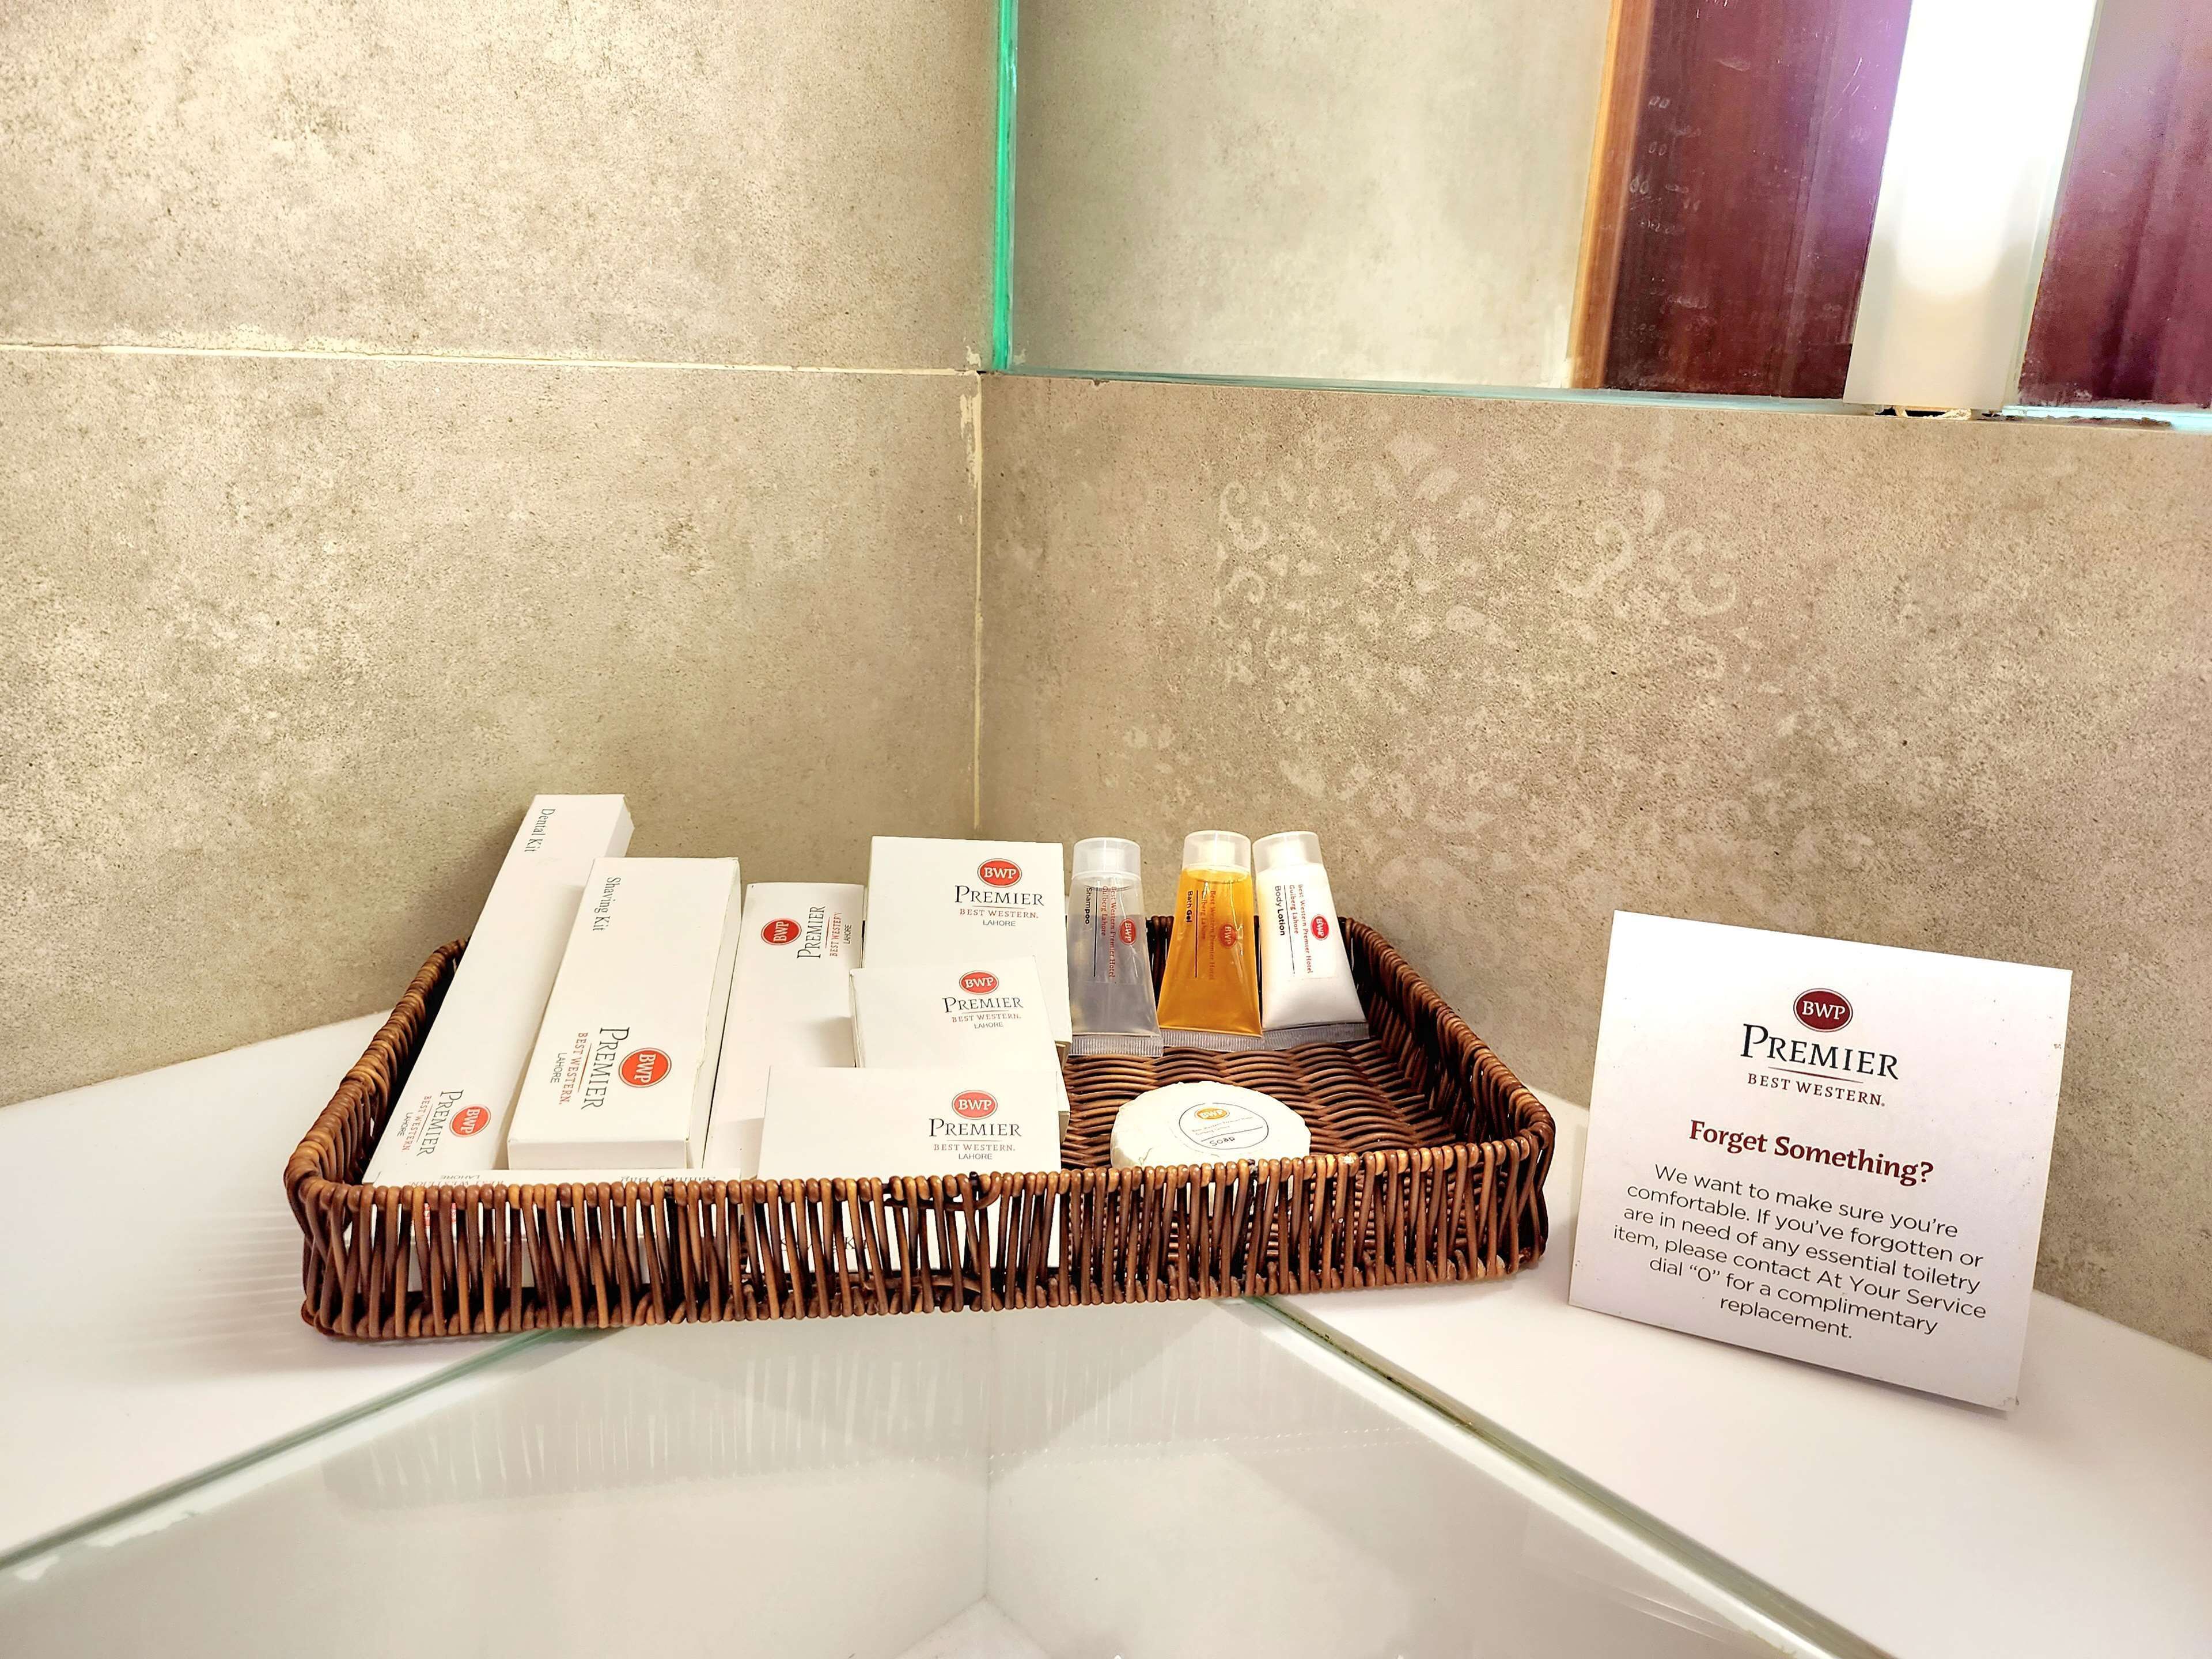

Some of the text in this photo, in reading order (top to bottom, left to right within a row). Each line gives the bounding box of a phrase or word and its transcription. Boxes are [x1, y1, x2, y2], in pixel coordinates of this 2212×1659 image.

[524, 808, 555, 852] Dental Kit
[984, 867, 1017, 879] BWP
[593, 877, 622, 931] Shaving Kit
[955, 885, 1044, 906] PREMIER
[1085, 887, 1093, 925] Shampoo
[1100, 885, 1109, 912] Gulberg
[773, 921, 789, 944] BWP
[797, 906, 825, 959] PREMIER
[843, 925, 852, 945] LAHORE
[1277, 908, 1286, 936] Lotion
[830, 941, 839, 957] BEST
[964, 976, 994, 988] BWP
[942, 997, 1024, 1013] PREMIER
[1802, 1001, 1846, 1020] BWP
[952, 1015, 974, 1023] BEST
[573, 1032, 589, 1054] BEST
[1740, 1024, 1899, 1080] PREMIER
[550, 1052, 567, 1084] LAHORE
[581, 1027, 630, 1110] PREMIER
[634, 1054, 656, 1084] BWP
[1747, 1073, 1790, 1090] BEST
[420, 1096, 431, 1113] BEST
[959, 1099, 992, 1111] BWP
[416, 1089, 464, 1157] PREMIER
[461, 1109, 480, 1135] BWP
[929, 1118, 1022, 1137] PREMIER
[1209, 1136, 1235, 1146] Soap
[1689, 1119, 1934, 1187] Forget Something?
[1655, 1164, 1687, 1184] We
[1694, 1175, 1743, 1196] want
[1749, 1184, 1770, 1200] to
[1776, 1191, 1832, 1213] make
[1839, 1204, 1884, 1222] sure
[1627, 1185, 1750, 1222] comfortable.
[1757, 1209, 1770, 1224] If
[1850, 1228, 1953, 1263] forgotten
[1960, 1253, 1984, 1268] or
[1624, 1207, 1980, 1294] are in need of any essential toiletry
[1613, 1225, 1987, 1319] item, please contact At Your Service
[1649, 1257, 1683, 1277] dial
[1726, 1273, 1755, 1292] for
[1759, 1284, 1771, 1297] a
[1777, 1288, 1938, 1335] complimentary
[1719, 1297, 1853, 1339] replacement.
